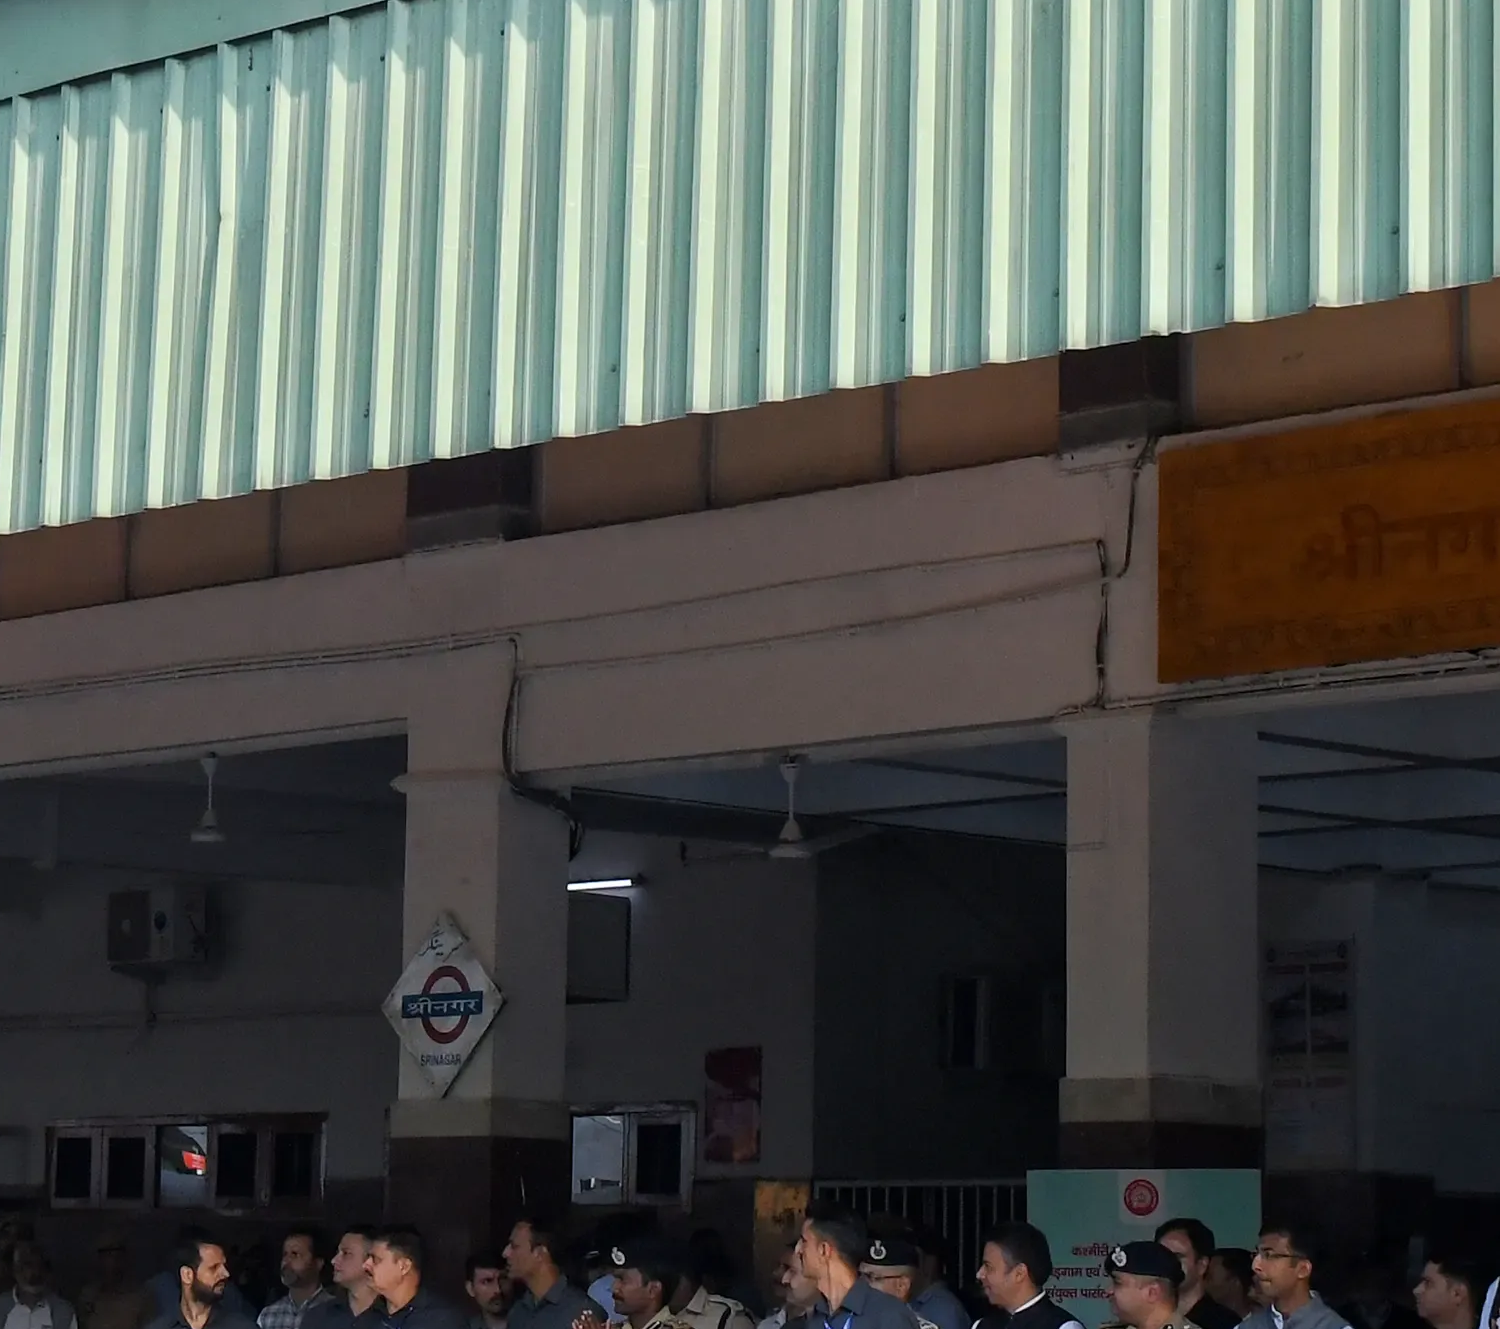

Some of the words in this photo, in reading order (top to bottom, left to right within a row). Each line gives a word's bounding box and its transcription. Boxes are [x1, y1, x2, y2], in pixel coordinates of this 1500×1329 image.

[407, 997, 480, 1015] श्रीनगर
[1052, 1268, 1083, 1280] ड़गाम
[1086, 1264, 1103, 1278] एवं
